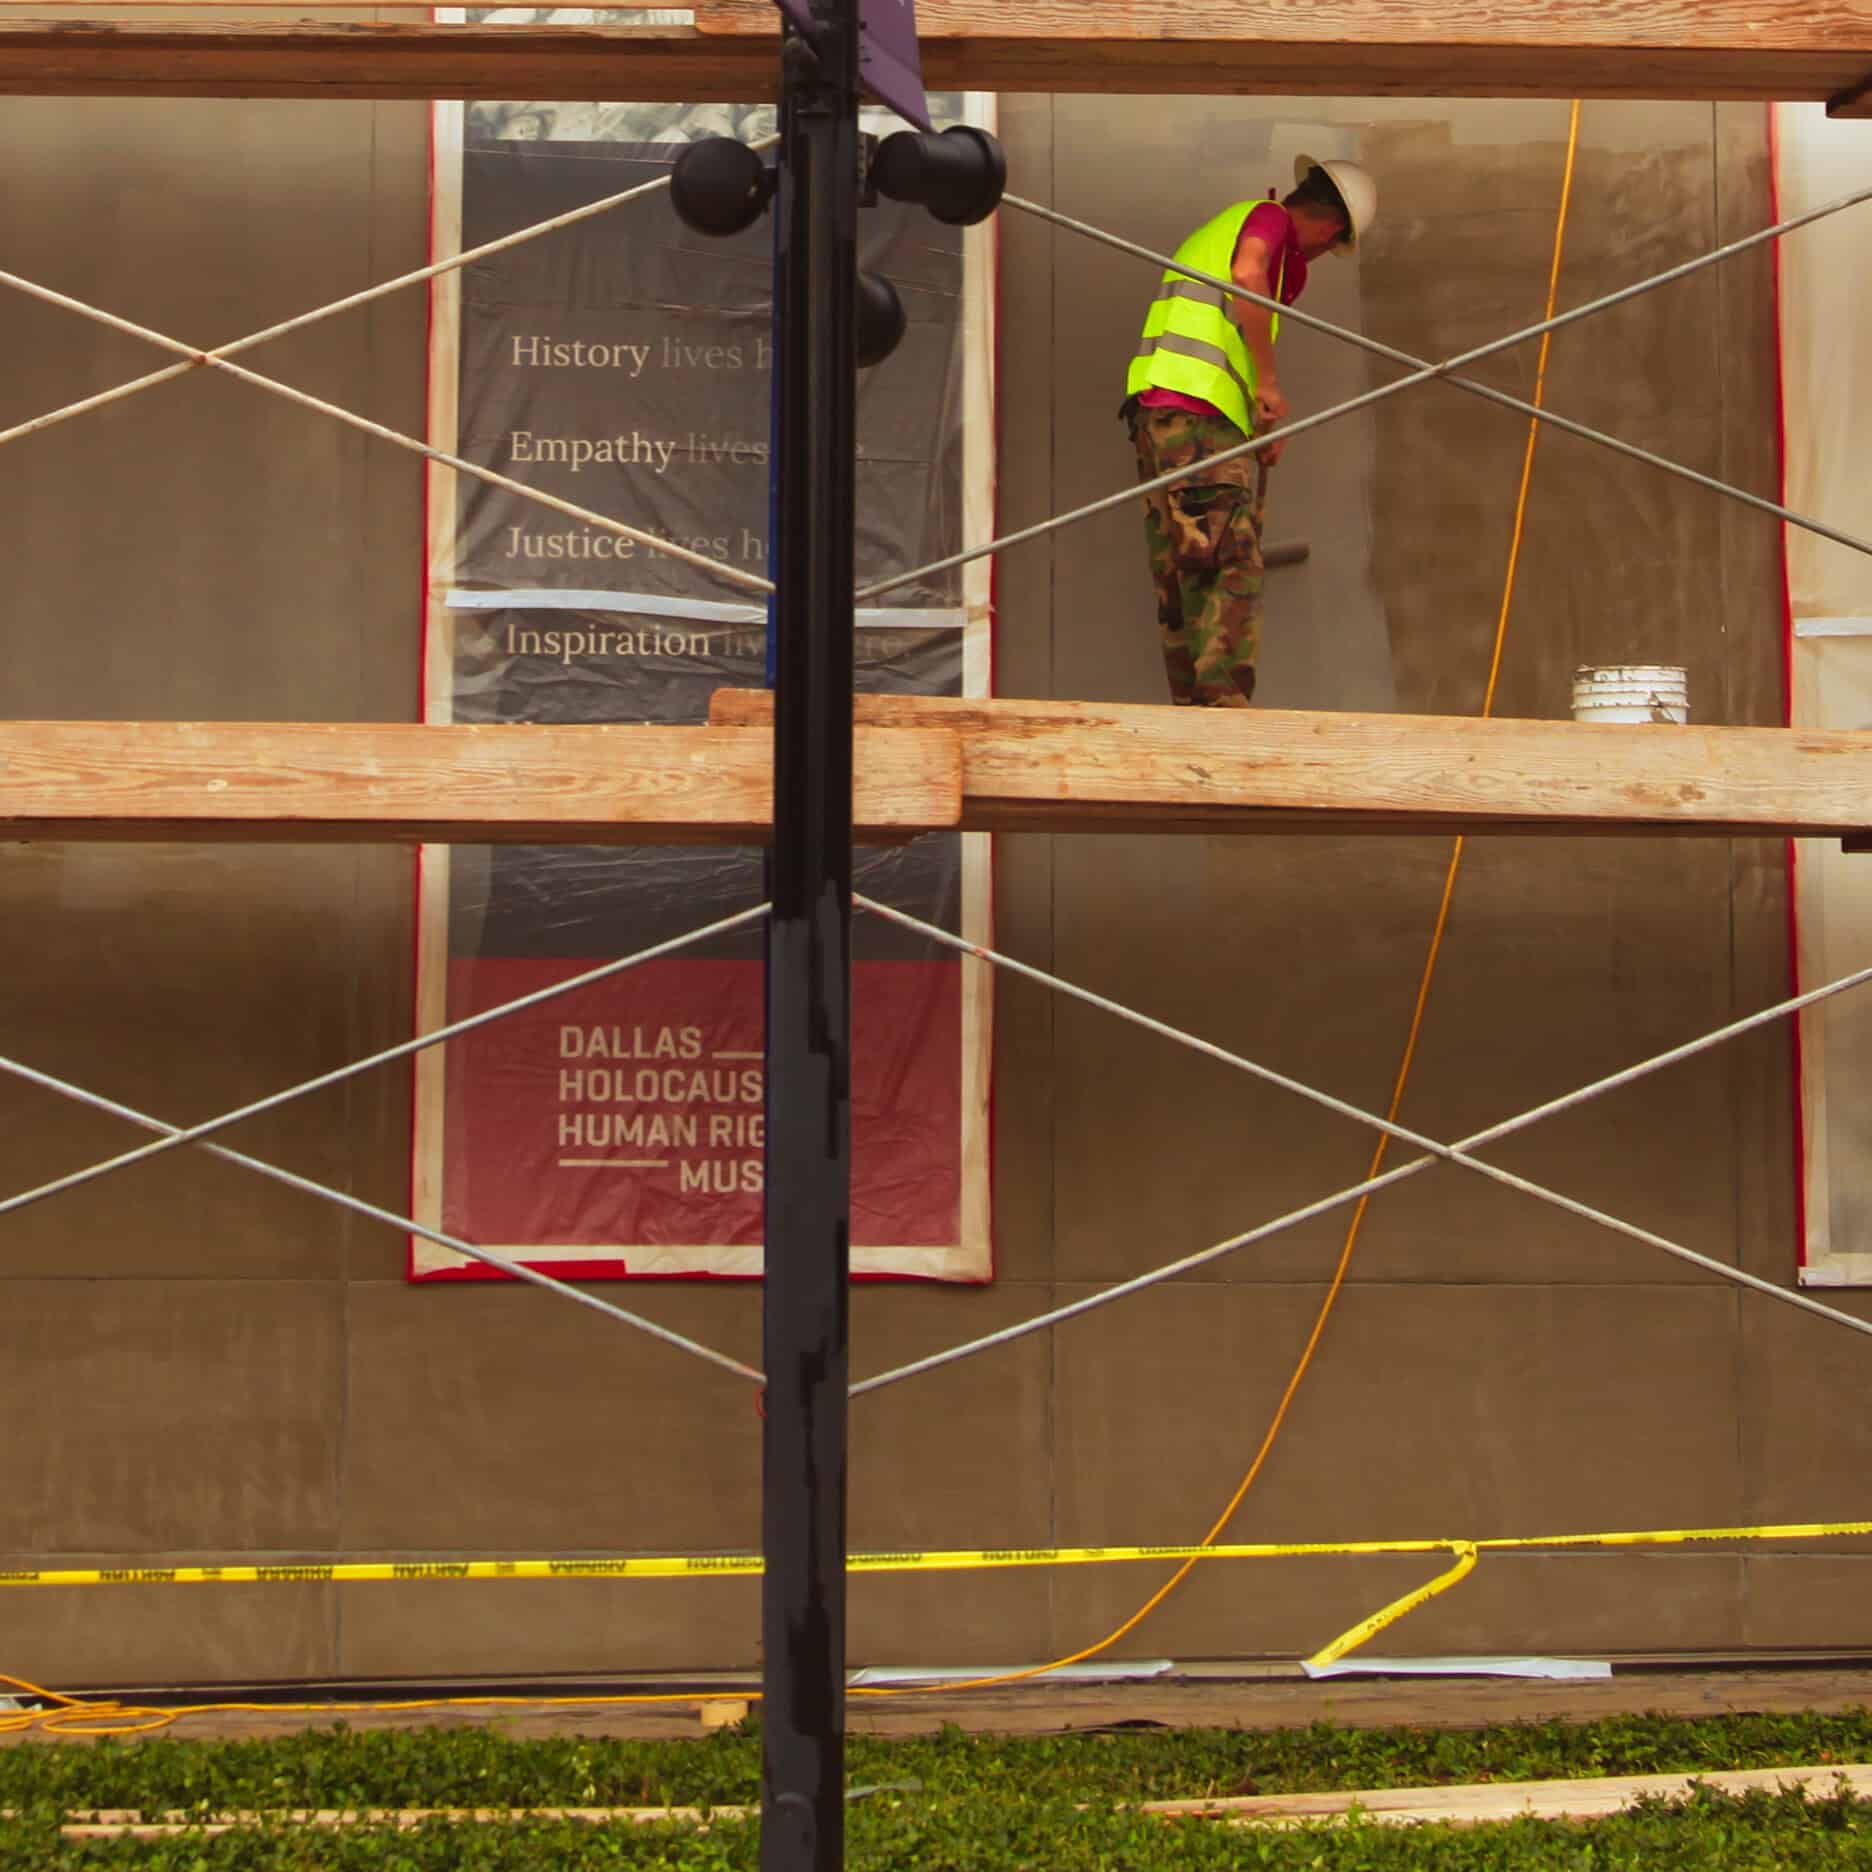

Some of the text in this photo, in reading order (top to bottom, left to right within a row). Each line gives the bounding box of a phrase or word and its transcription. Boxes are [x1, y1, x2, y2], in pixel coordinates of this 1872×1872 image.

[511, 335, 651, 378] History
[662, 336, 743, 369] lives
[509, 431, 769, 474] Empathy lives
[505, 526, 636, 559] Justice
[506, 623, 712, 665] Inspiration
[558, 1025, 703, 1060] DALLAS
[558, 1113, 699, 1148] HUMAN
